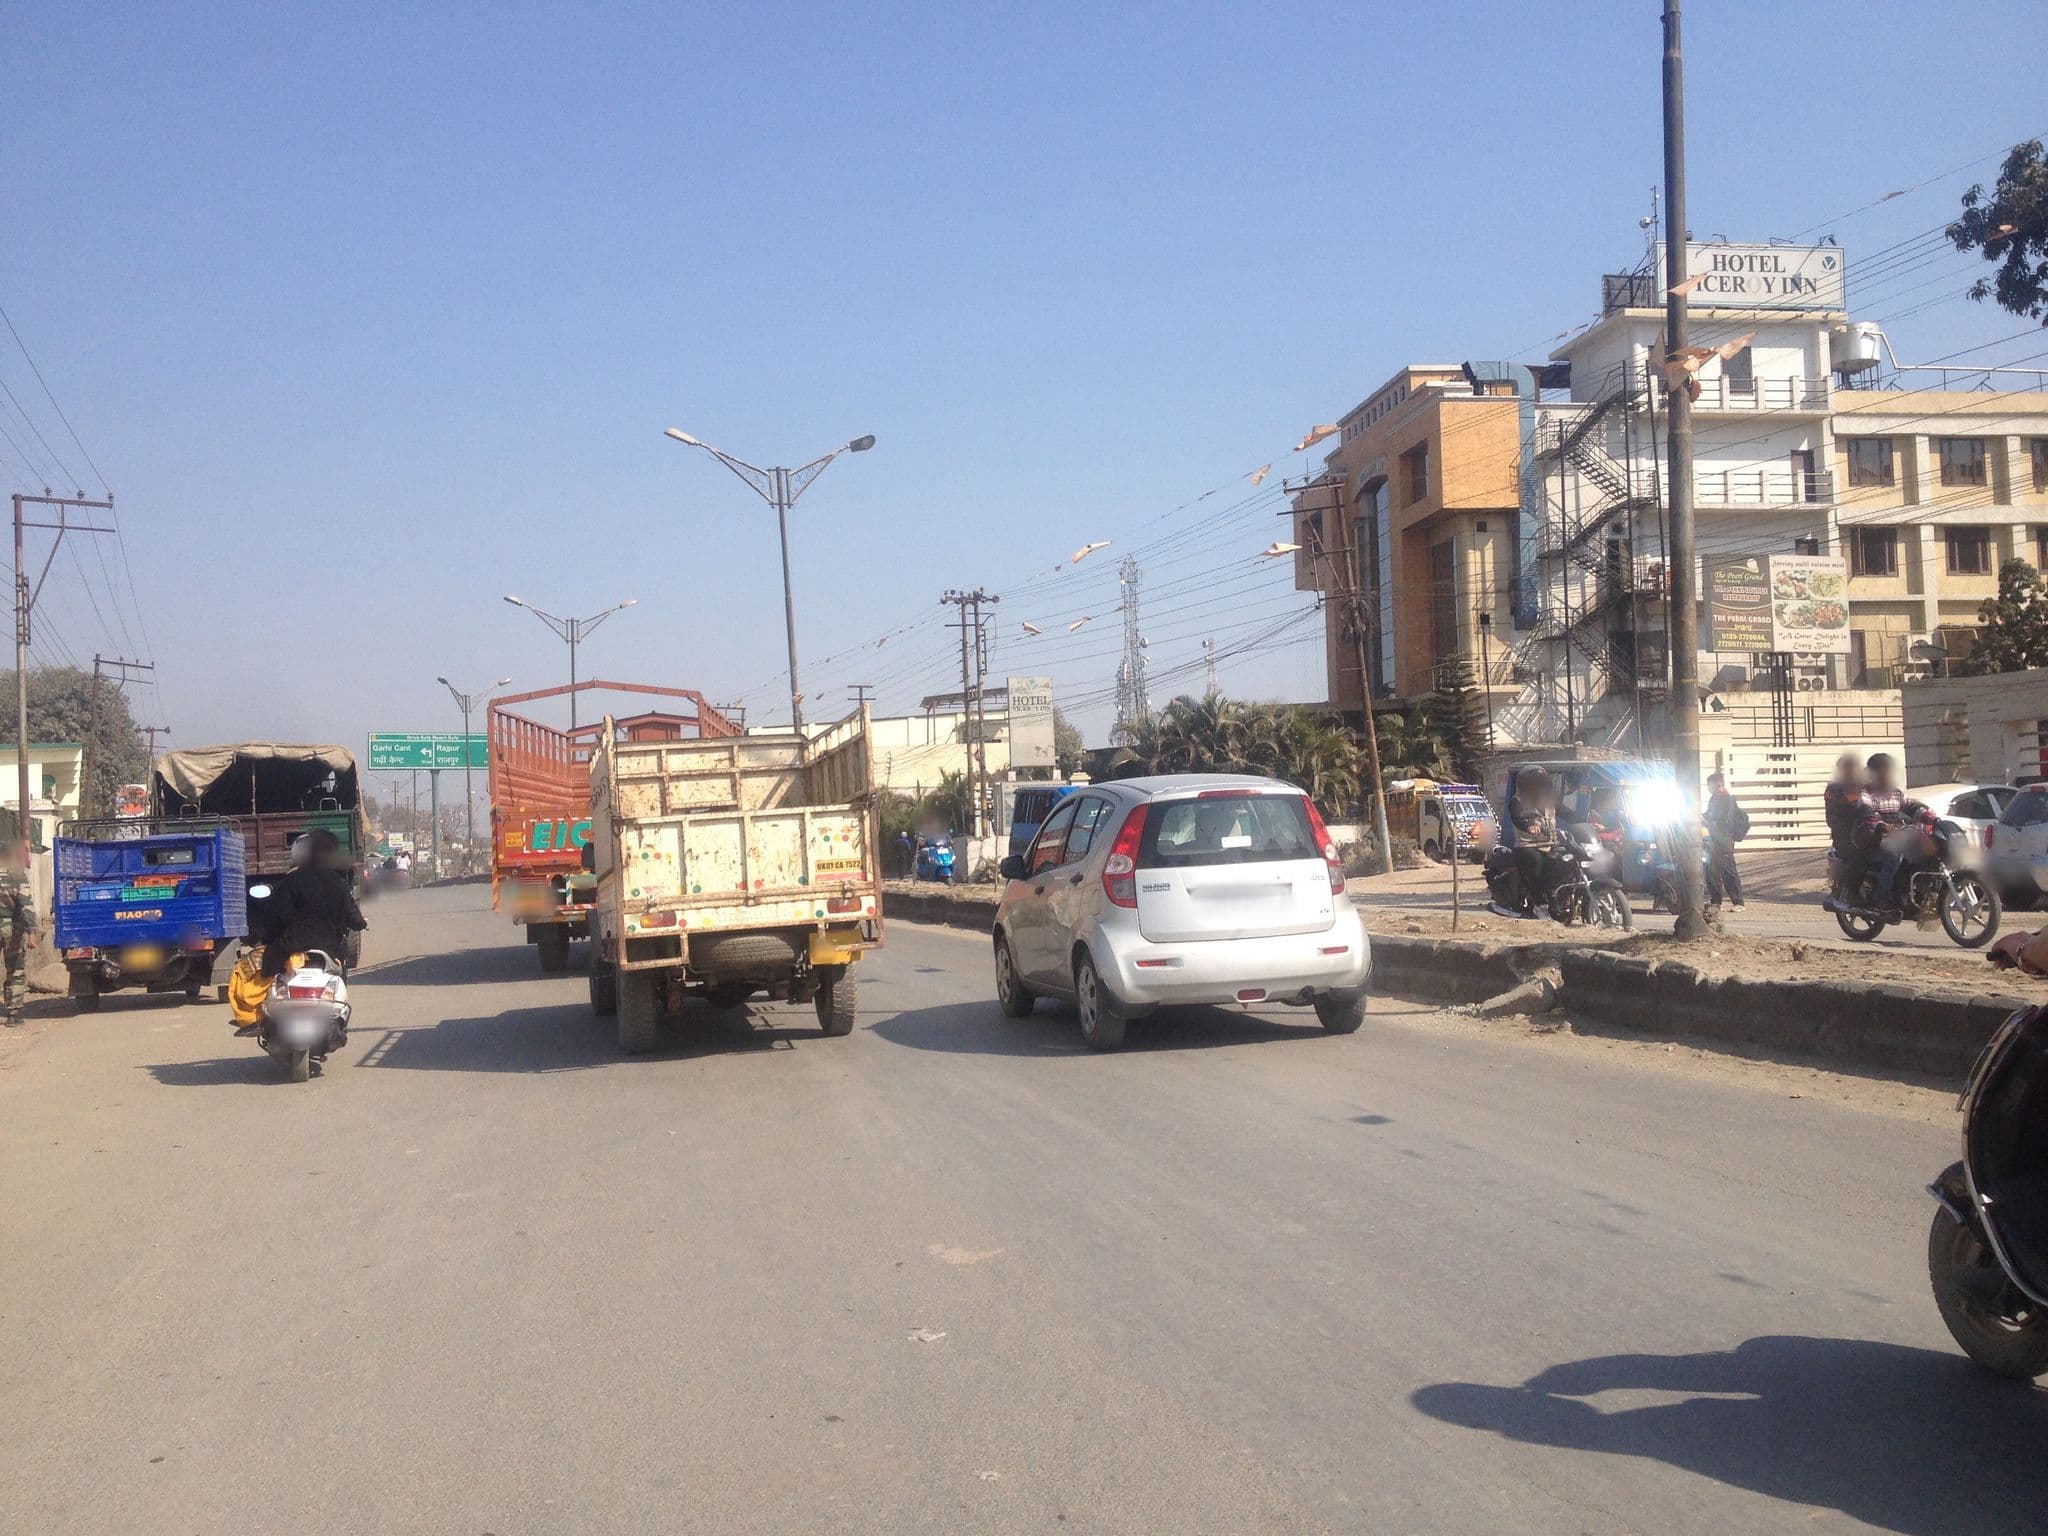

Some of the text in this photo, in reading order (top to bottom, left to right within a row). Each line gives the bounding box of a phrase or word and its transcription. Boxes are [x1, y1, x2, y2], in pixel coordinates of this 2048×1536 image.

[1712, 254, 1786, 273] HOTEL
[1692, 275, 1817, 295] ICEROY INN
[1714, 571, 1726, 579] The
[1727, 615, 1747, 623] PEARL
[1748, 616, 1772, 624] GRAND
[1012, 696, 1050, 706] HOTEL
[372, 744, 392, 752] Garhi
[436, 744, 460, 753] Rajpur
